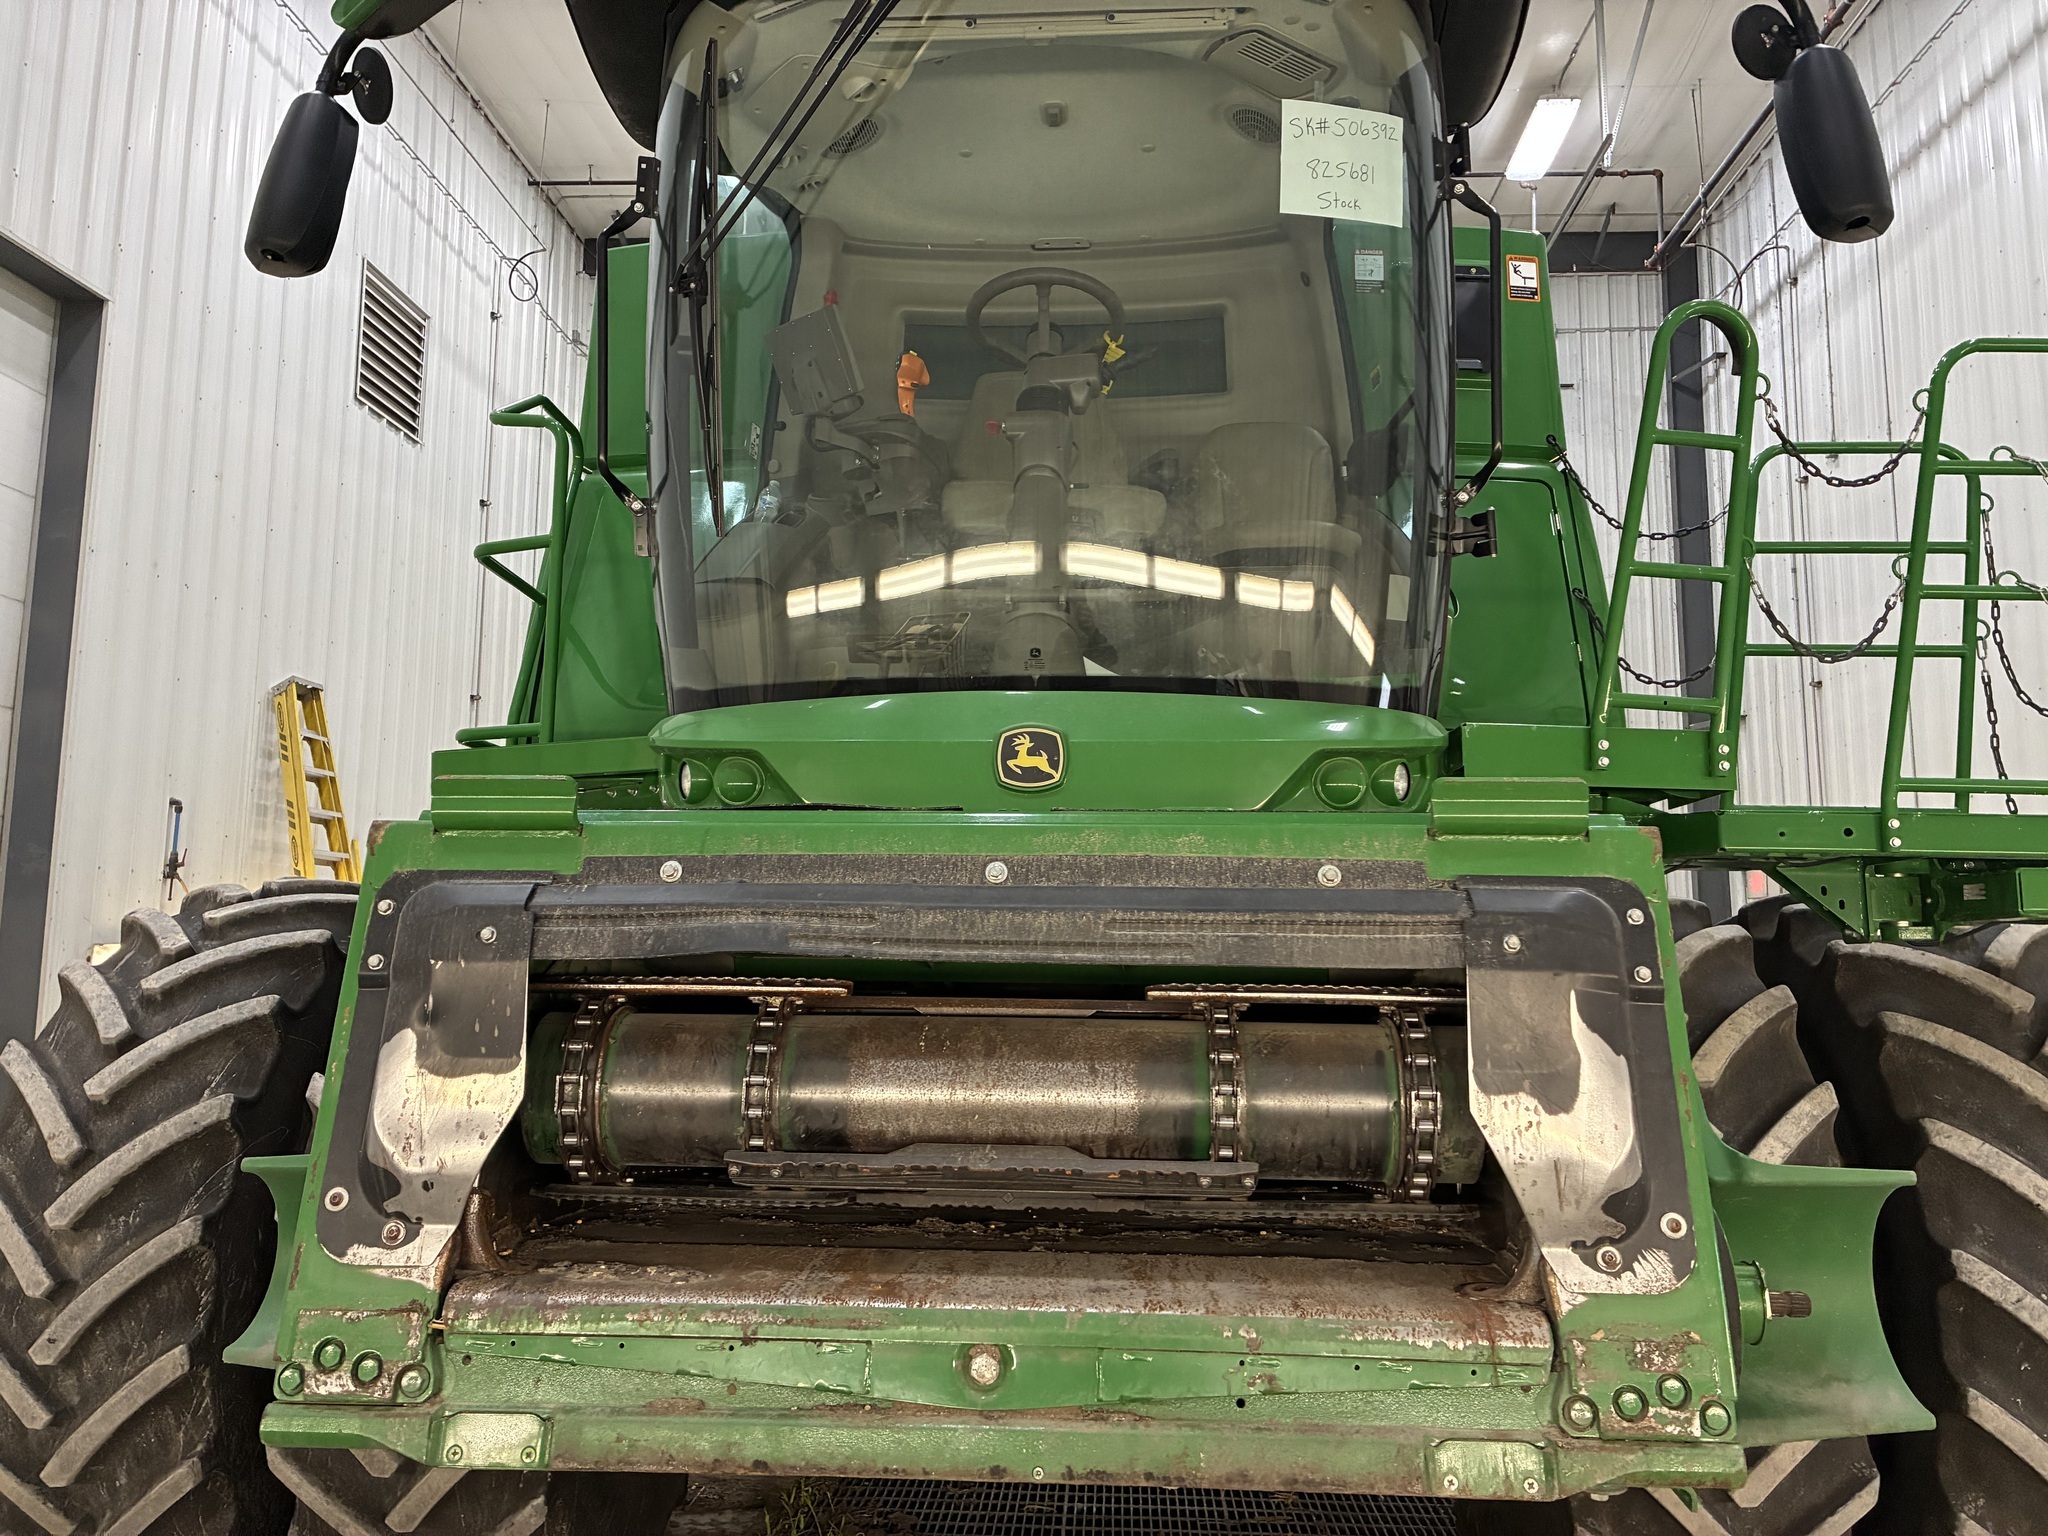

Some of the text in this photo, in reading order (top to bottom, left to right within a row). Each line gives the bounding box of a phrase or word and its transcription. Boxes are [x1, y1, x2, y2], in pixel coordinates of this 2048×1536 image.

[1289, 118, 1398, 141] SK#506392
[1306, 158, 1374, 184] 825681
[1317, 191, 1361, 210] Stock
